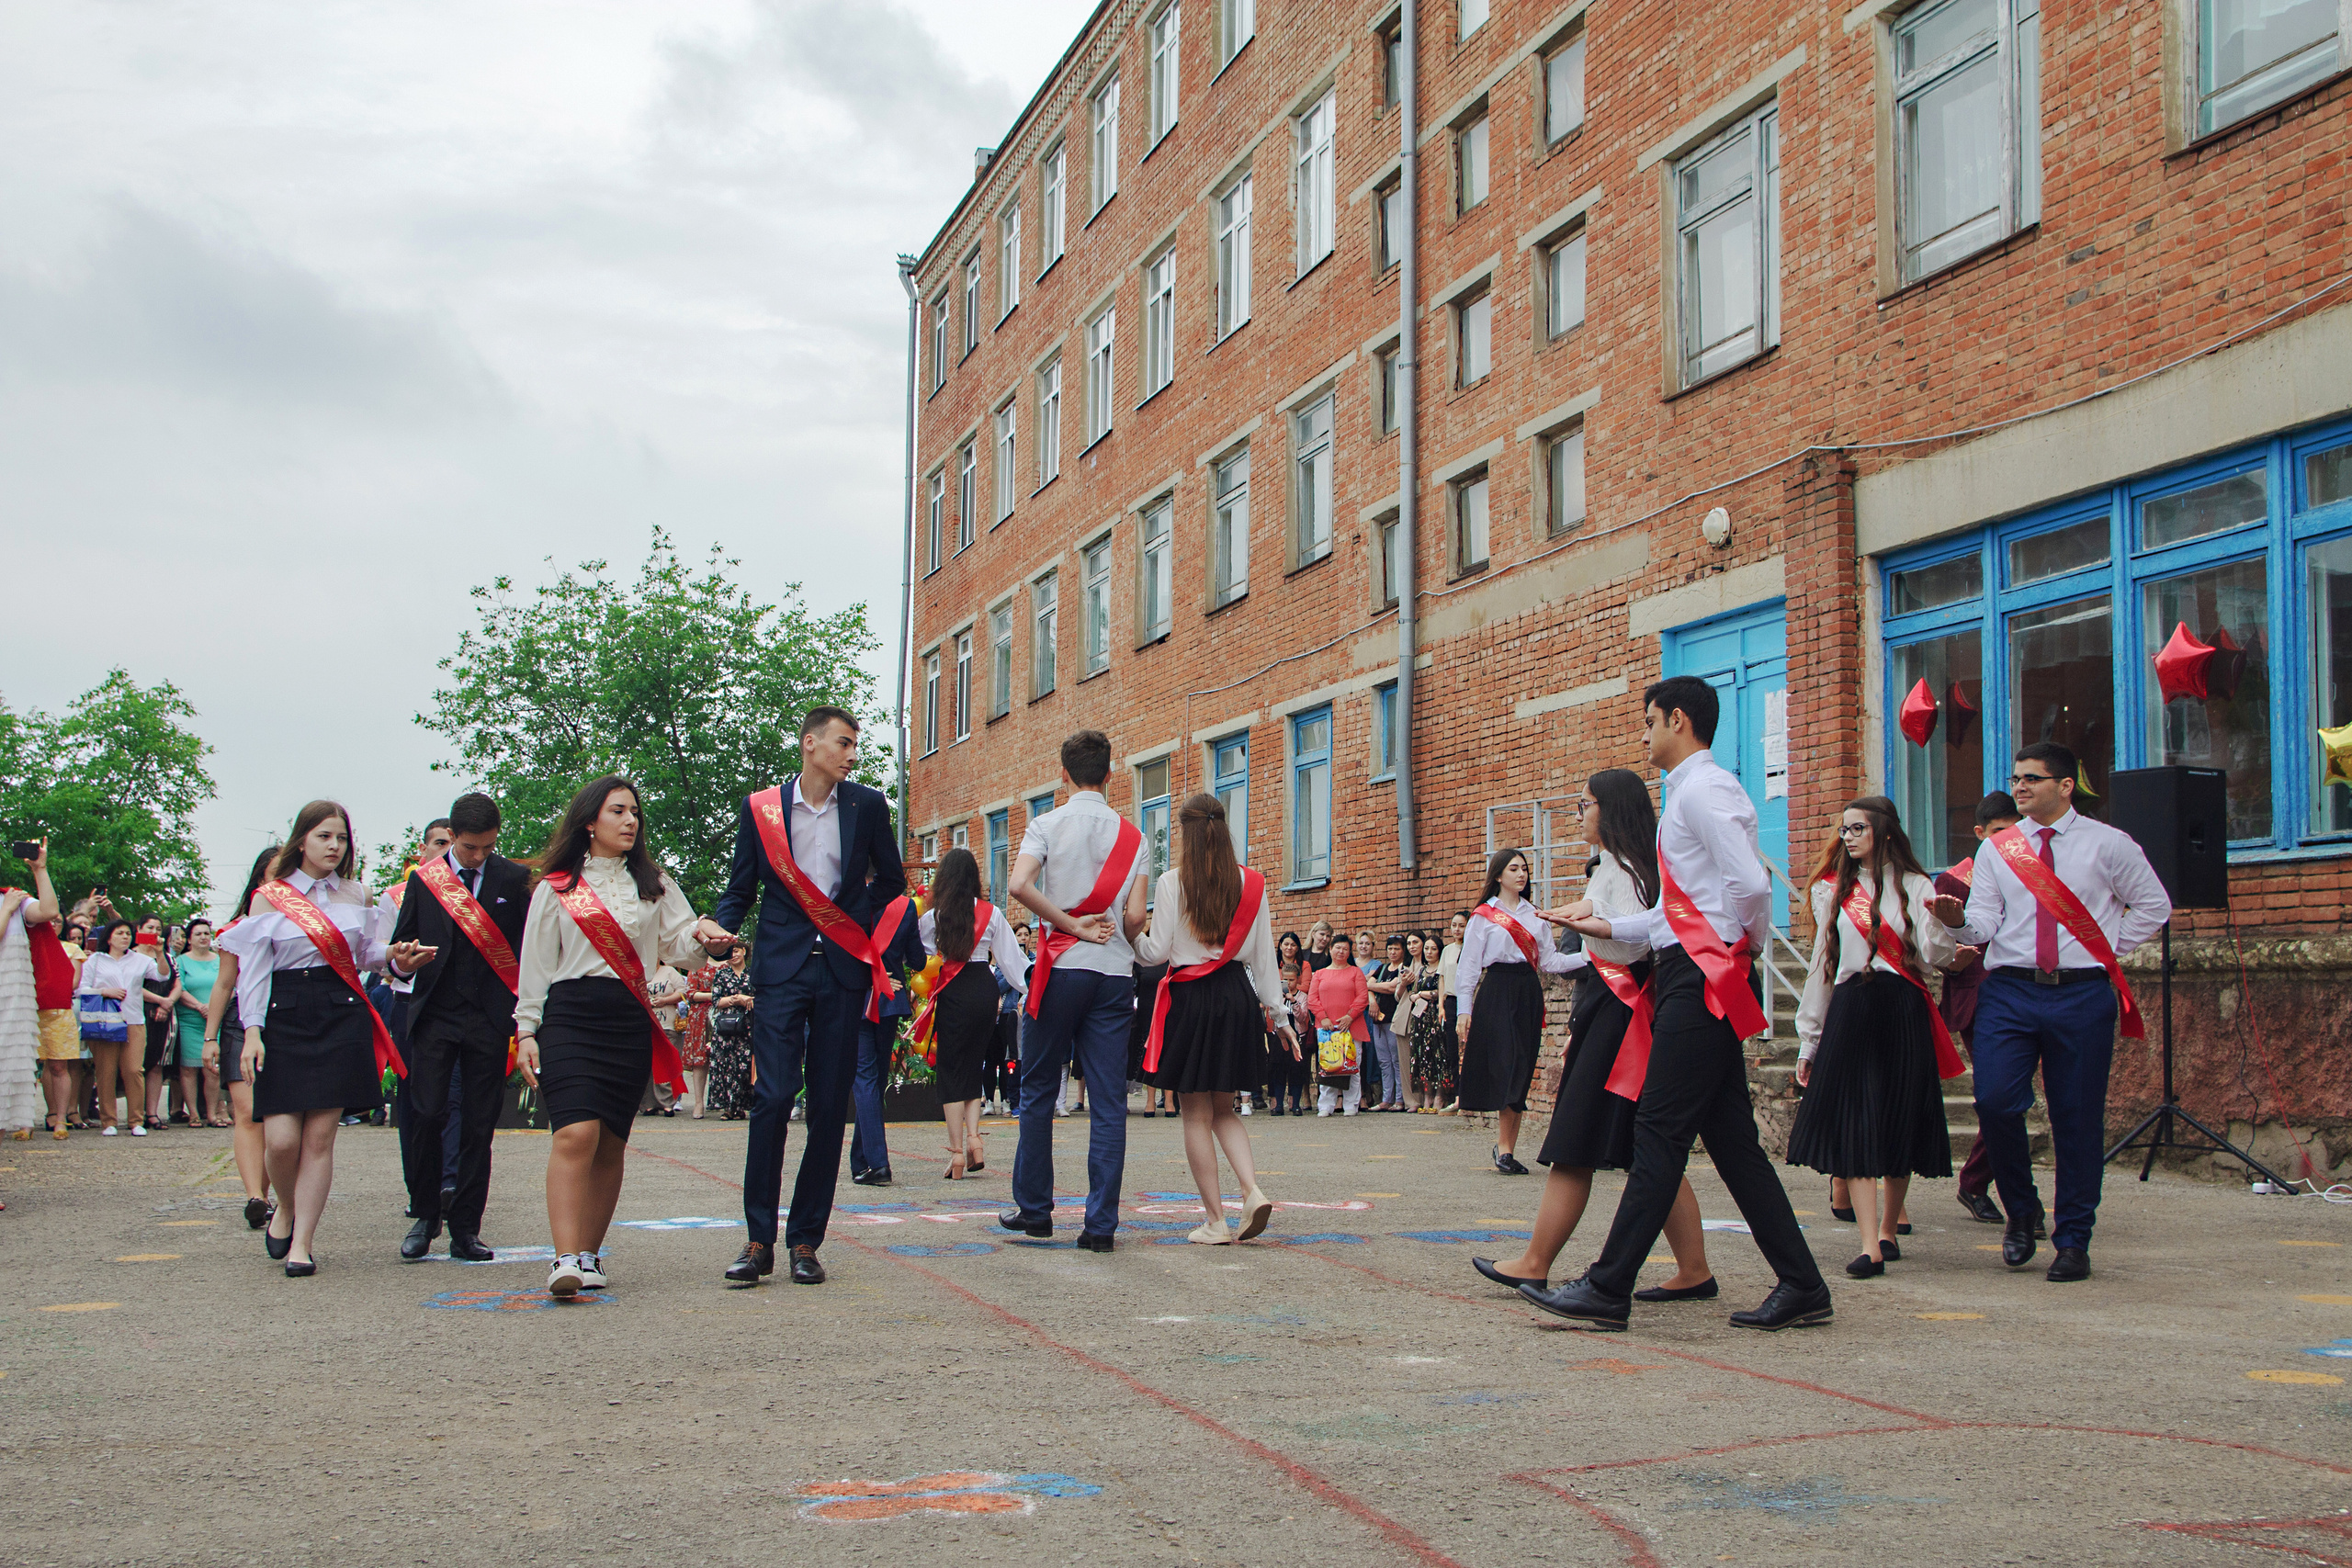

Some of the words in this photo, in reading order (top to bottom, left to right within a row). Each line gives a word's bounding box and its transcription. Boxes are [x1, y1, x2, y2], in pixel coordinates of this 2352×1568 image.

[282, 897, 340, 957] Выпускник
[440, 883, 496, 944] Выпускник
[485, 944, 518, 969] 2021
[807, 903, 846, 929] 2021
[2014, 854, 2075, 917] Выпускник
[2067, 915, 2101, 942] 2021
[581, 907, 639, 976] Выпускник
